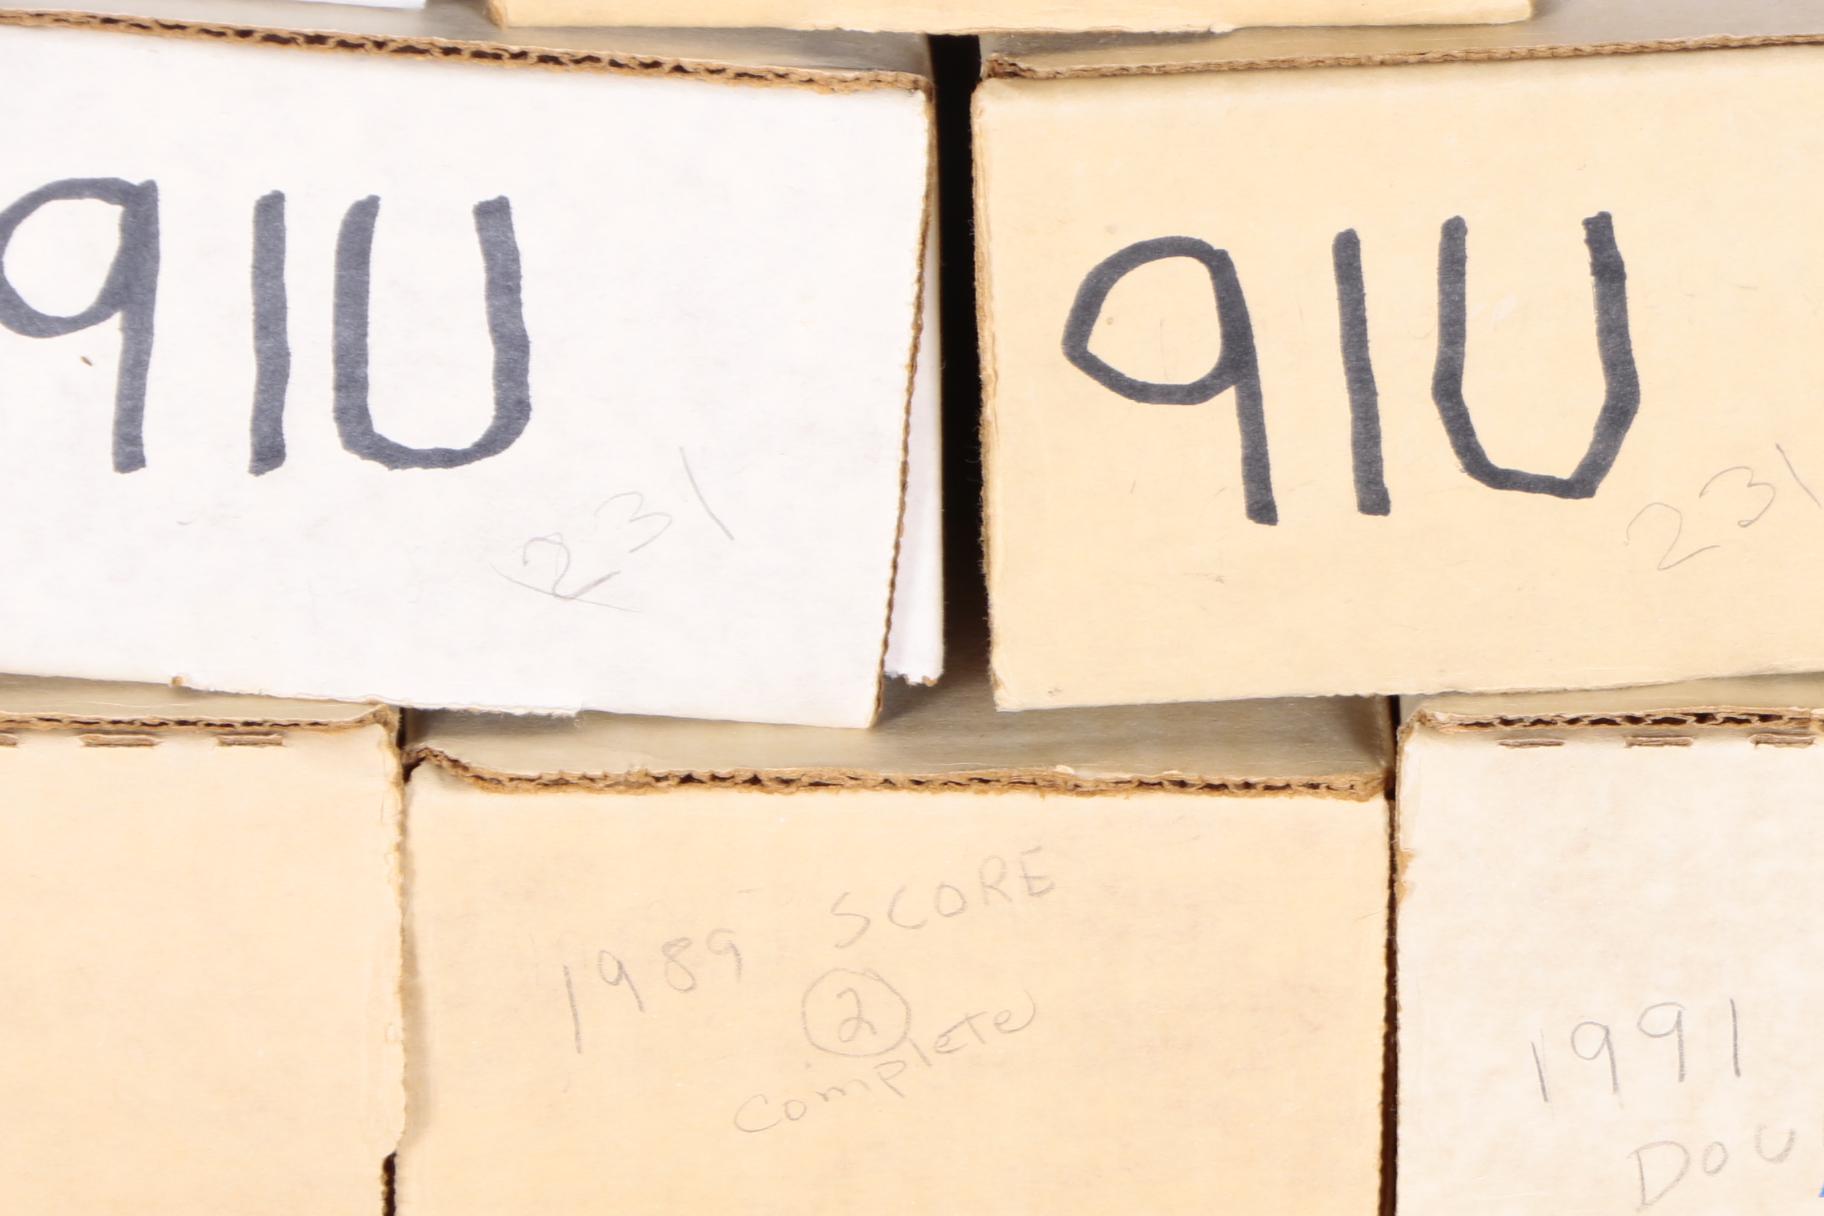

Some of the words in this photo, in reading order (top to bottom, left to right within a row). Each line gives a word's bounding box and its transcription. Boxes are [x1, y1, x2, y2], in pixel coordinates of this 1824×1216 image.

[0, 176, 532, 477] 91U
[1062, 210, 1641, 526] 91U
[1625, 443, 1823, 571] 231
[559, 928, 745, 1056] 1989
[831, 845, 1058, 950] SCORE
[1529, 998, 1744, 1105] 1991
